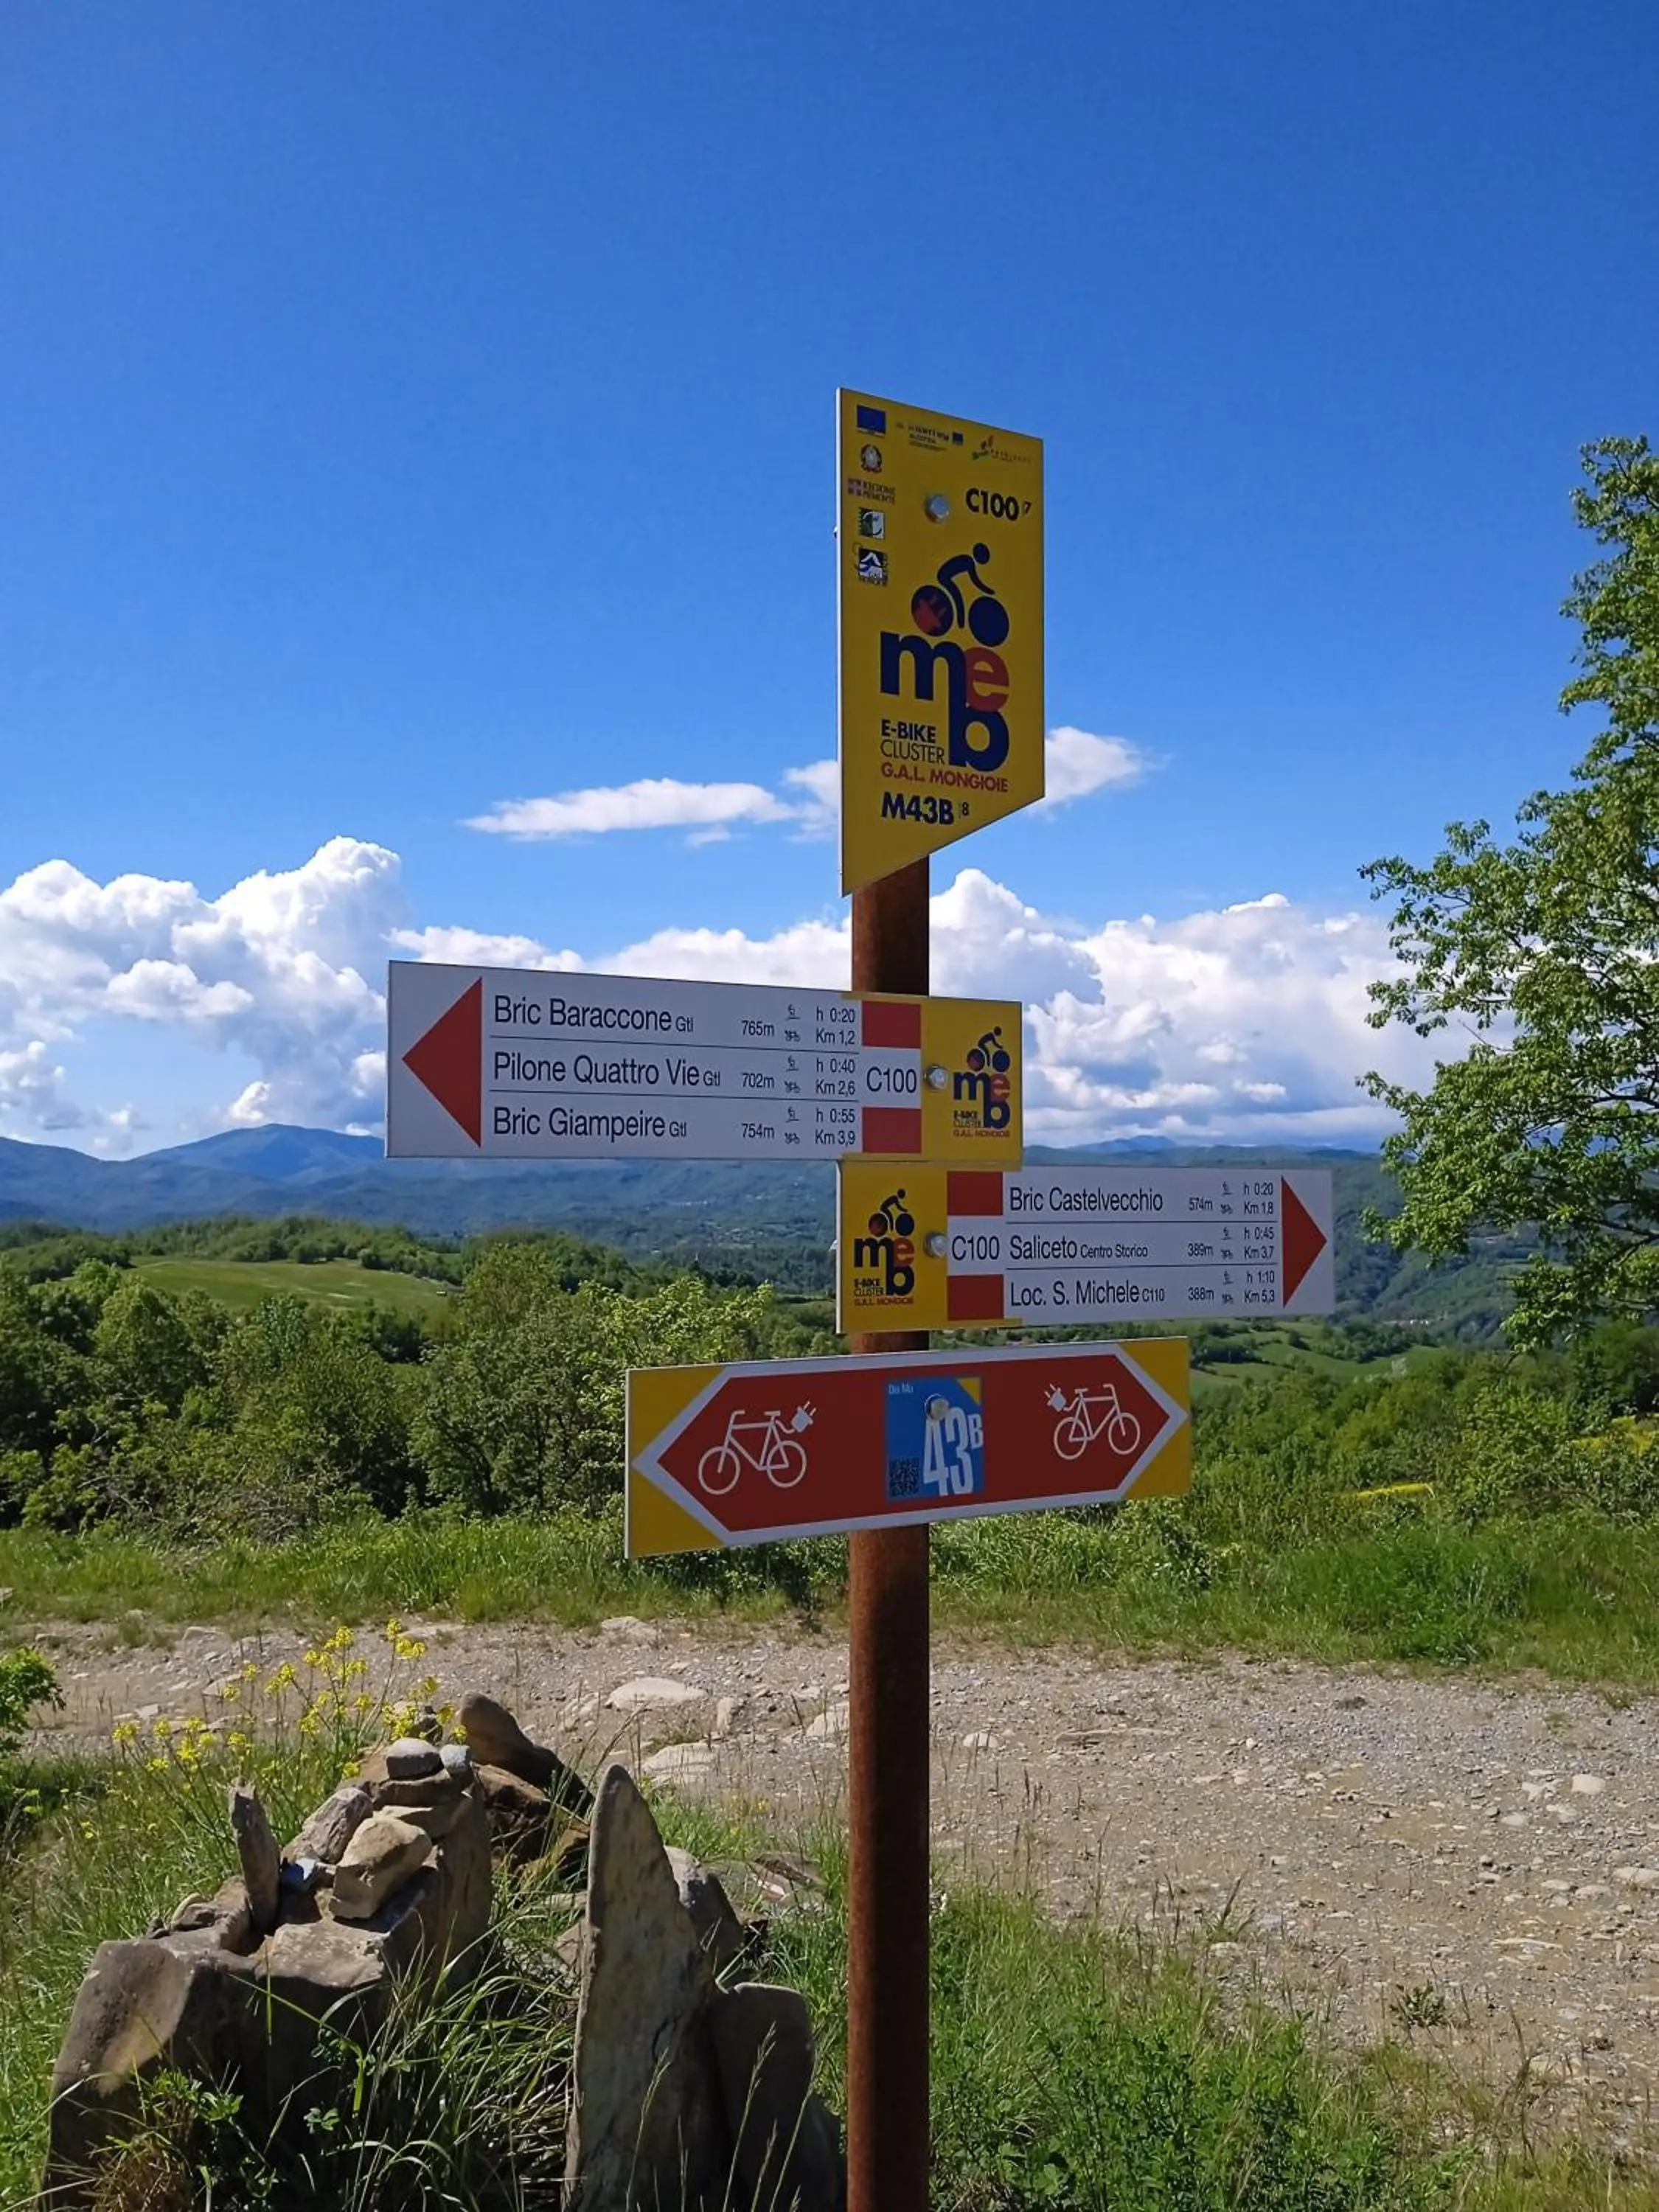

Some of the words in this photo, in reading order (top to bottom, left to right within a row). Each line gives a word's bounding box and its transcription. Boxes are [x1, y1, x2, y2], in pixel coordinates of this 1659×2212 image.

[966, 487, 1019, 521] C100
[882, 720, 936, 743] E-BIKE
[880, 739, 945, 765] CLUSTER
[880, 762, 926, 782] G.A.L.
[930, 771, 1008, 792] MONGIOIE
[881, 792, 954, 825] M43B
[495, 995, 541, 1024] Bric
[550, 998, 672, 1031] Baraccone
[816, 1006, 824, 1022] h
[830, 1008, 855, 1023] 0:20
[741, 1020, 774, 1037] 765m
[815, 1028, 835, 1044] Km
[839, 1031, 855, 1046] 1,2
[495, 1051, 566, 1082] Pilone
[574, 1055, 660, 1085] Quattro
[666, 1058, 700, 1086] Vie
[816, 1057, 824, 1073] h
[830, 1058, 855, 1074] 0:40
[742, 1072, 774, 1088] 702m
[815, 1079, 835, 1095] Km
[838, 1082, 855, 1096] 2,6
[866, 1066, 917, 1093] C100
[816, 1107, 824, 1123] h
[830, 1108, 855, 1123] 0:55
[493, 1107, 541, 1135] Bric
[549, 1107, 665, 1143] Giampeire
[741, 1122, 774, 1138] 754m
[815, 1129, 835, 1144] Km
[837, 1130, 855, 1145] 3,9
[1244, 1181, 1250, 1195] h
[1254, 1182, 1273, 1196] 0:20
[1010, 1187, 1043, 1211] Bric
[1049, 1186, 1164, 1211] Castelvecchio
[1189, 1197, 1213, 1211] 574m
[1244, 1203, 1259, 1215] Km
[1244, 1226, 1250, 1239] h
[1254, 1226, 1275, 1240] 0:45
[952, 1236, 1000, 1261] C100
[1009, 1235, 1077, 1260] Saliceto
[1080, 1244, 1113, 1259] Centro
[1115, 1243, 1148, 1258] Storico
[1244, 1249, 1259, 1260] Km
[1246, 1270, 1253, 1284] h
[1257, 1270, 1275, 1284] 1:10
[1011, 1281, 1046, 1307] Loc.
[1052, 1280, 1069, 1306] S.
[1076, 1279, 1140, 1304] Michele
[1142, 1288, 1165, 1302] C110
[1243, 1292, 1259, 1303] Km
